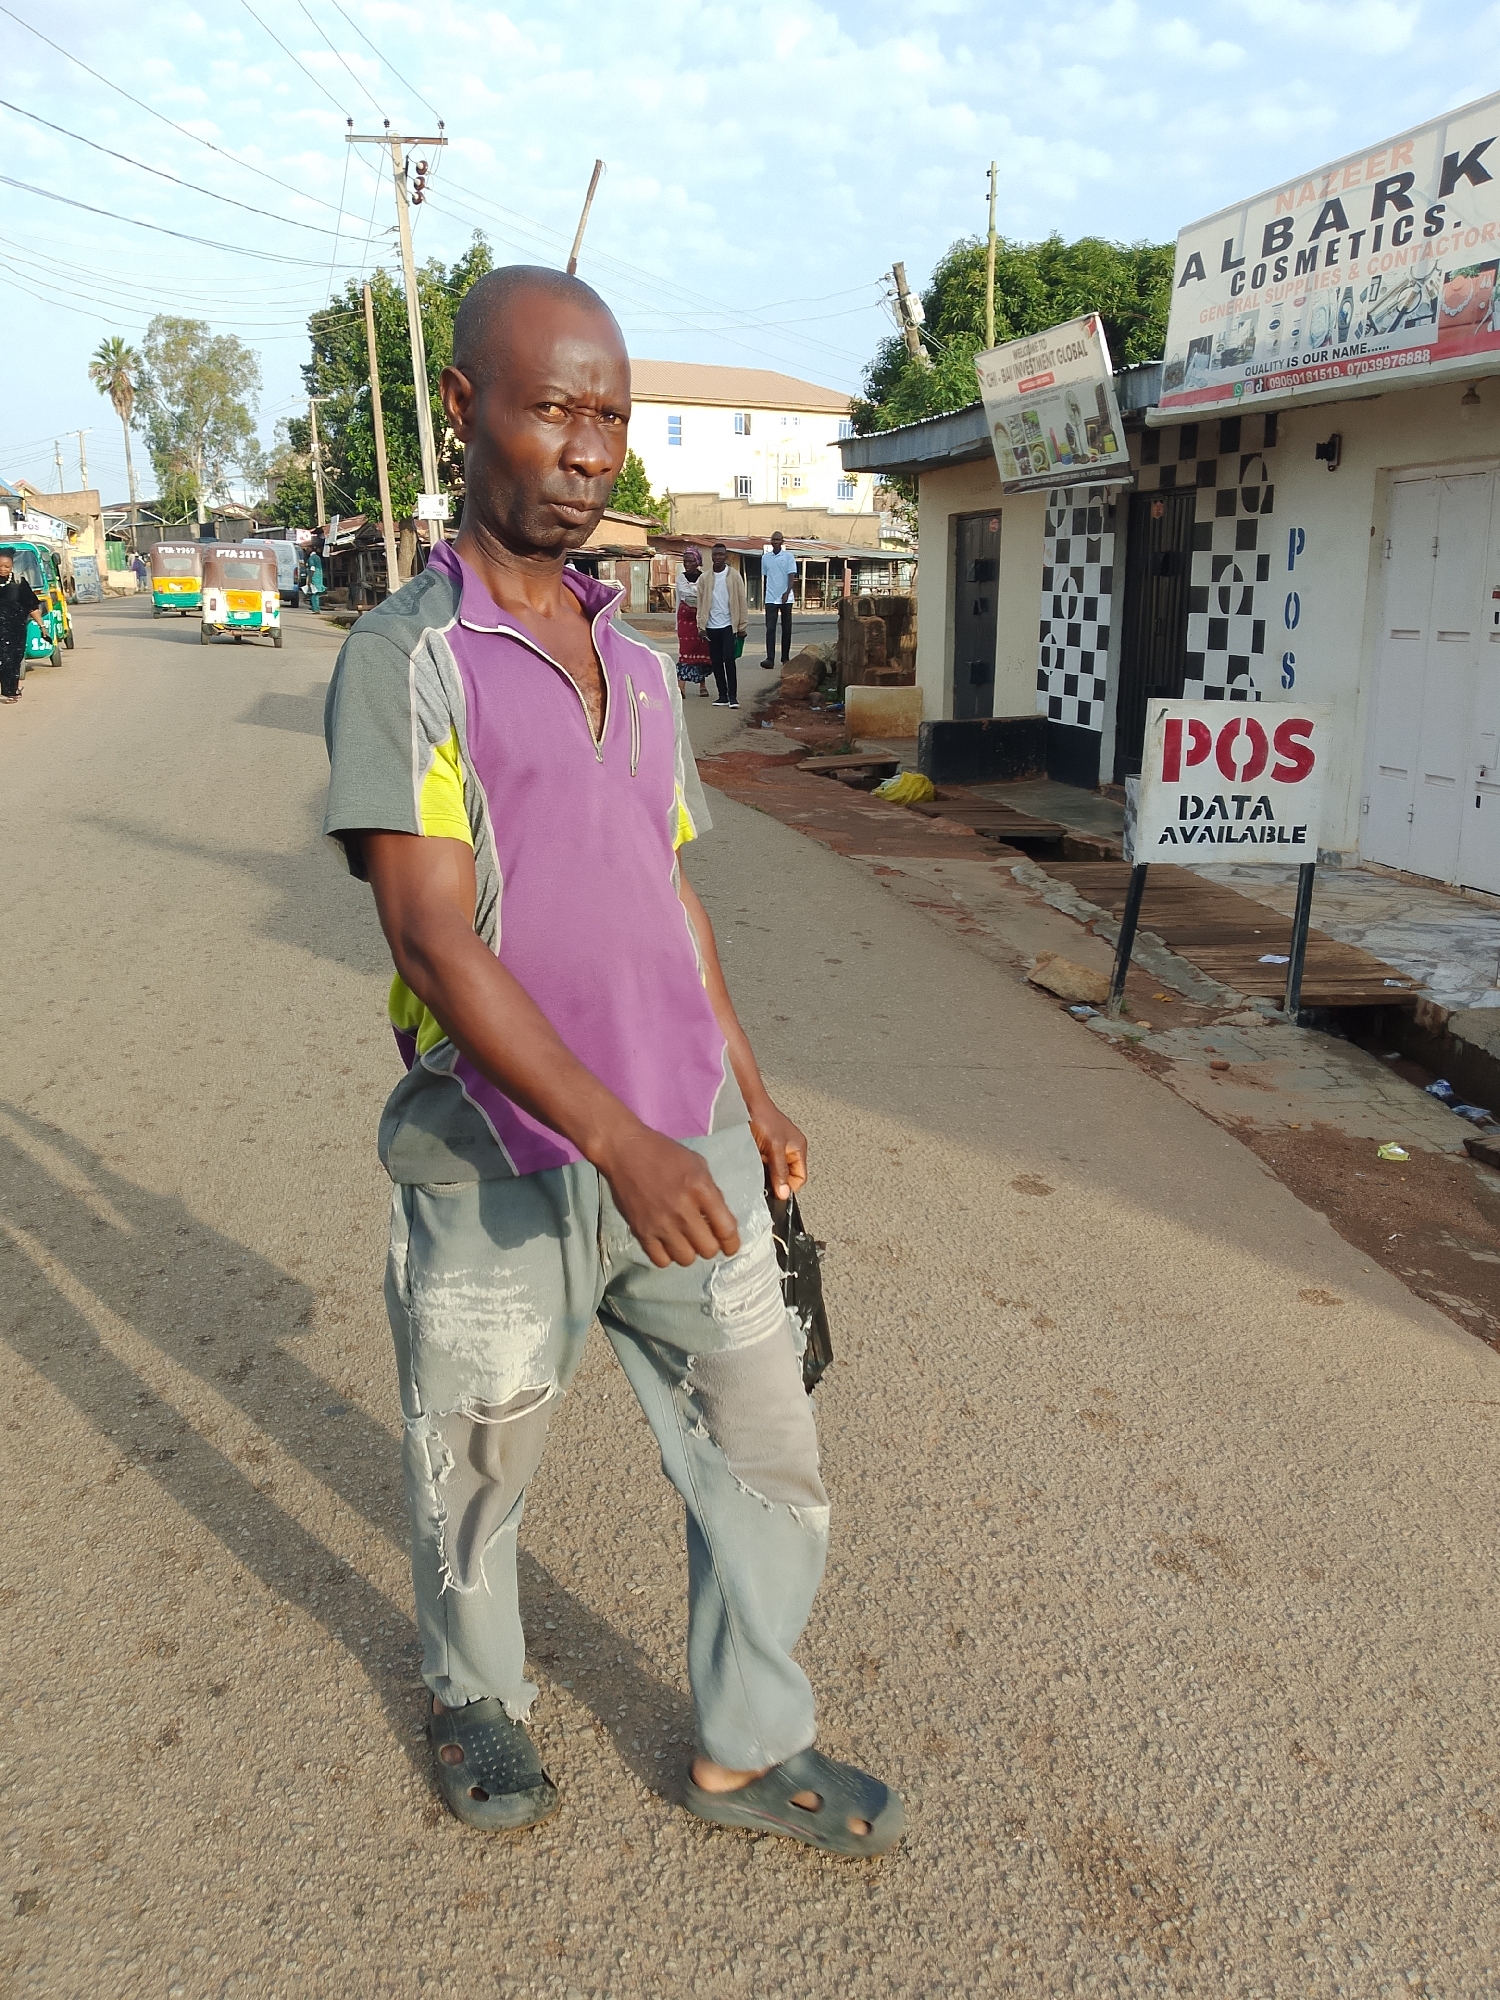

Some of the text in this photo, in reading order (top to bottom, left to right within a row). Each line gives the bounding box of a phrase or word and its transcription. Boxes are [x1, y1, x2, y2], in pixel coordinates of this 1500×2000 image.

[1275, 140, 1415, 215] NAZEER
[1199, 296, 1260, 324] GENERAL
[1264, 267, 1342, 303] SUPPLIES
[1347, 262, 1359, 281] &
[1056, 339, 1088, 365] GLOBAL
[1244, 359, 1285, 377] QUALITY
[1287, 356, 1299, 368] IS
[1302, 350, 1328, 364] OUR
[1347, 349, 1430, 376] 07039976888
[1161, 717, 1316, 784] POS
[1178, 795, 1275, 821] DATA
[1157, 824, 1308, 845] AVAILABLE
